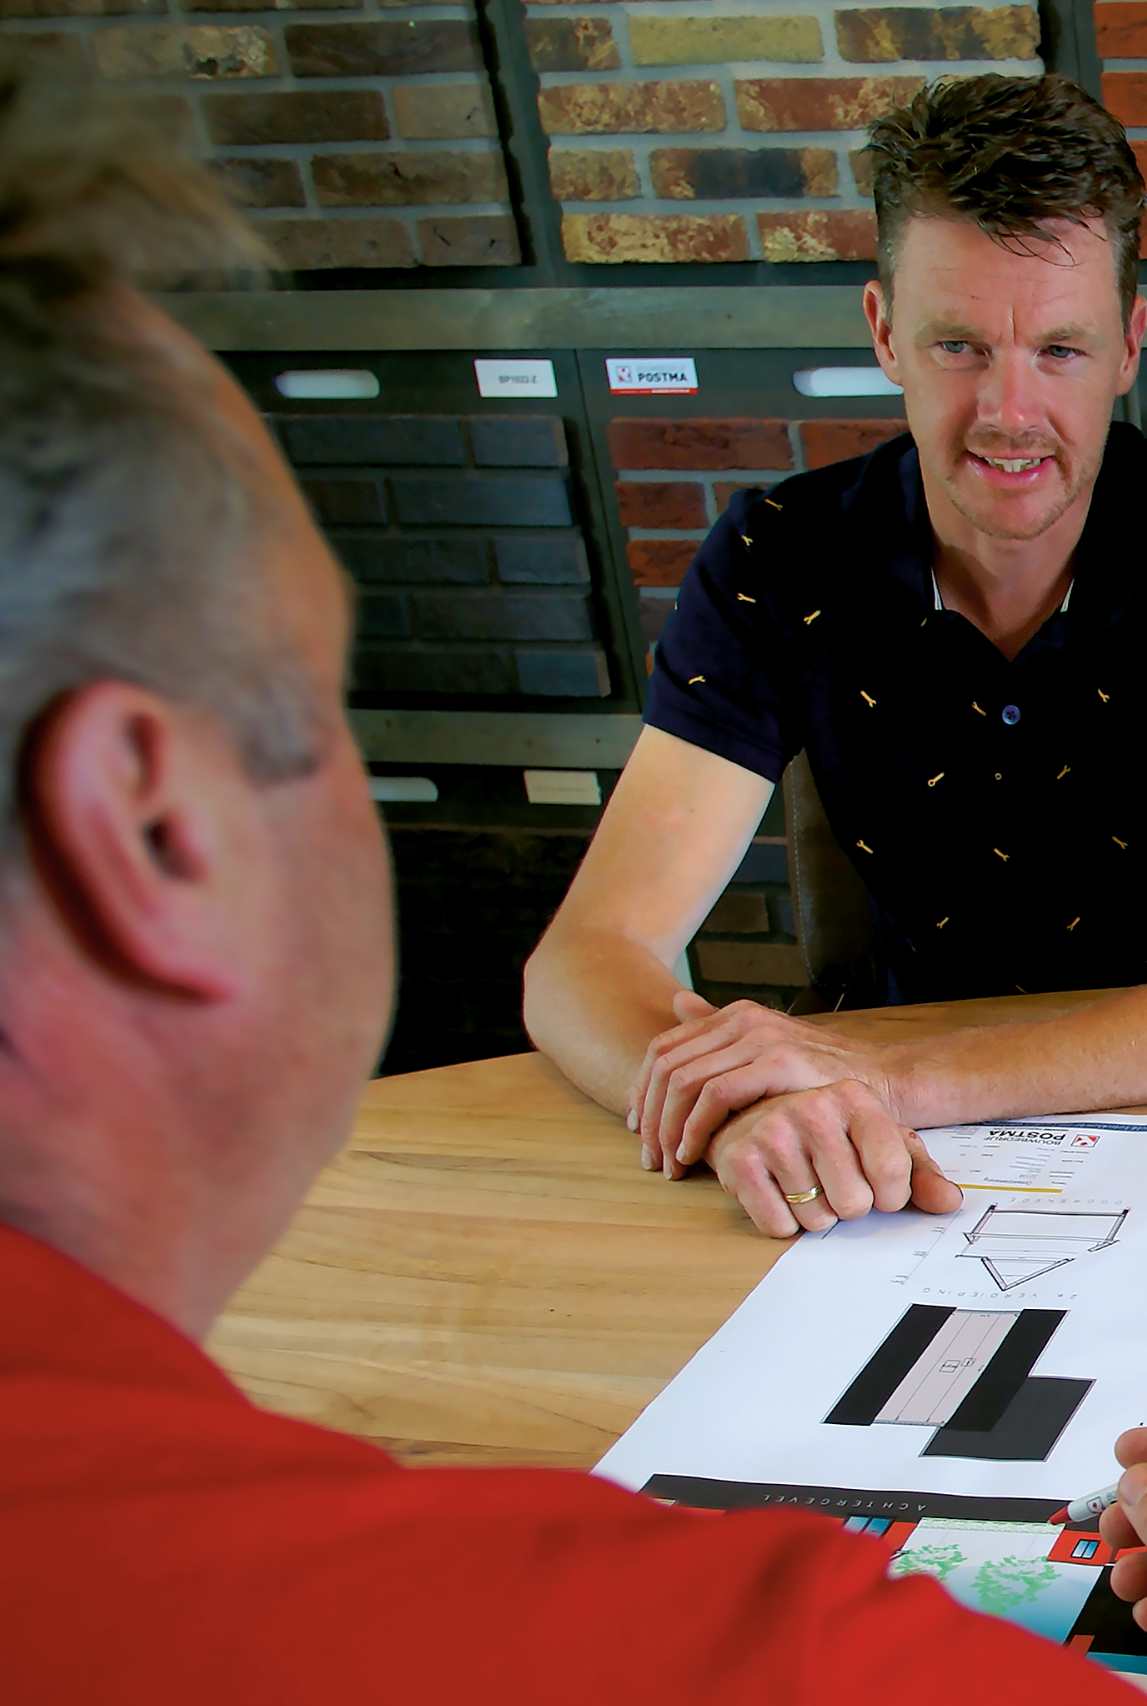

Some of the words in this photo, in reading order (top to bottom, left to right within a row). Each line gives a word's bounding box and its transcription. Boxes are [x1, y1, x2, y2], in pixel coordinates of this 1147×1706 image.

[638, 372, 688, 382] POSTMA
[988, 1130, 1066, 1140] POSTMA
[983, 1136, 1061, 1145] BOUWBEDRIJF
[1008, 1197, 1122, 1205] DOORSNEDE
[922, 1288, 1037, 1298] VERDIEPING
[762, 1494, 926, 1511] ACHTERGEVEL
